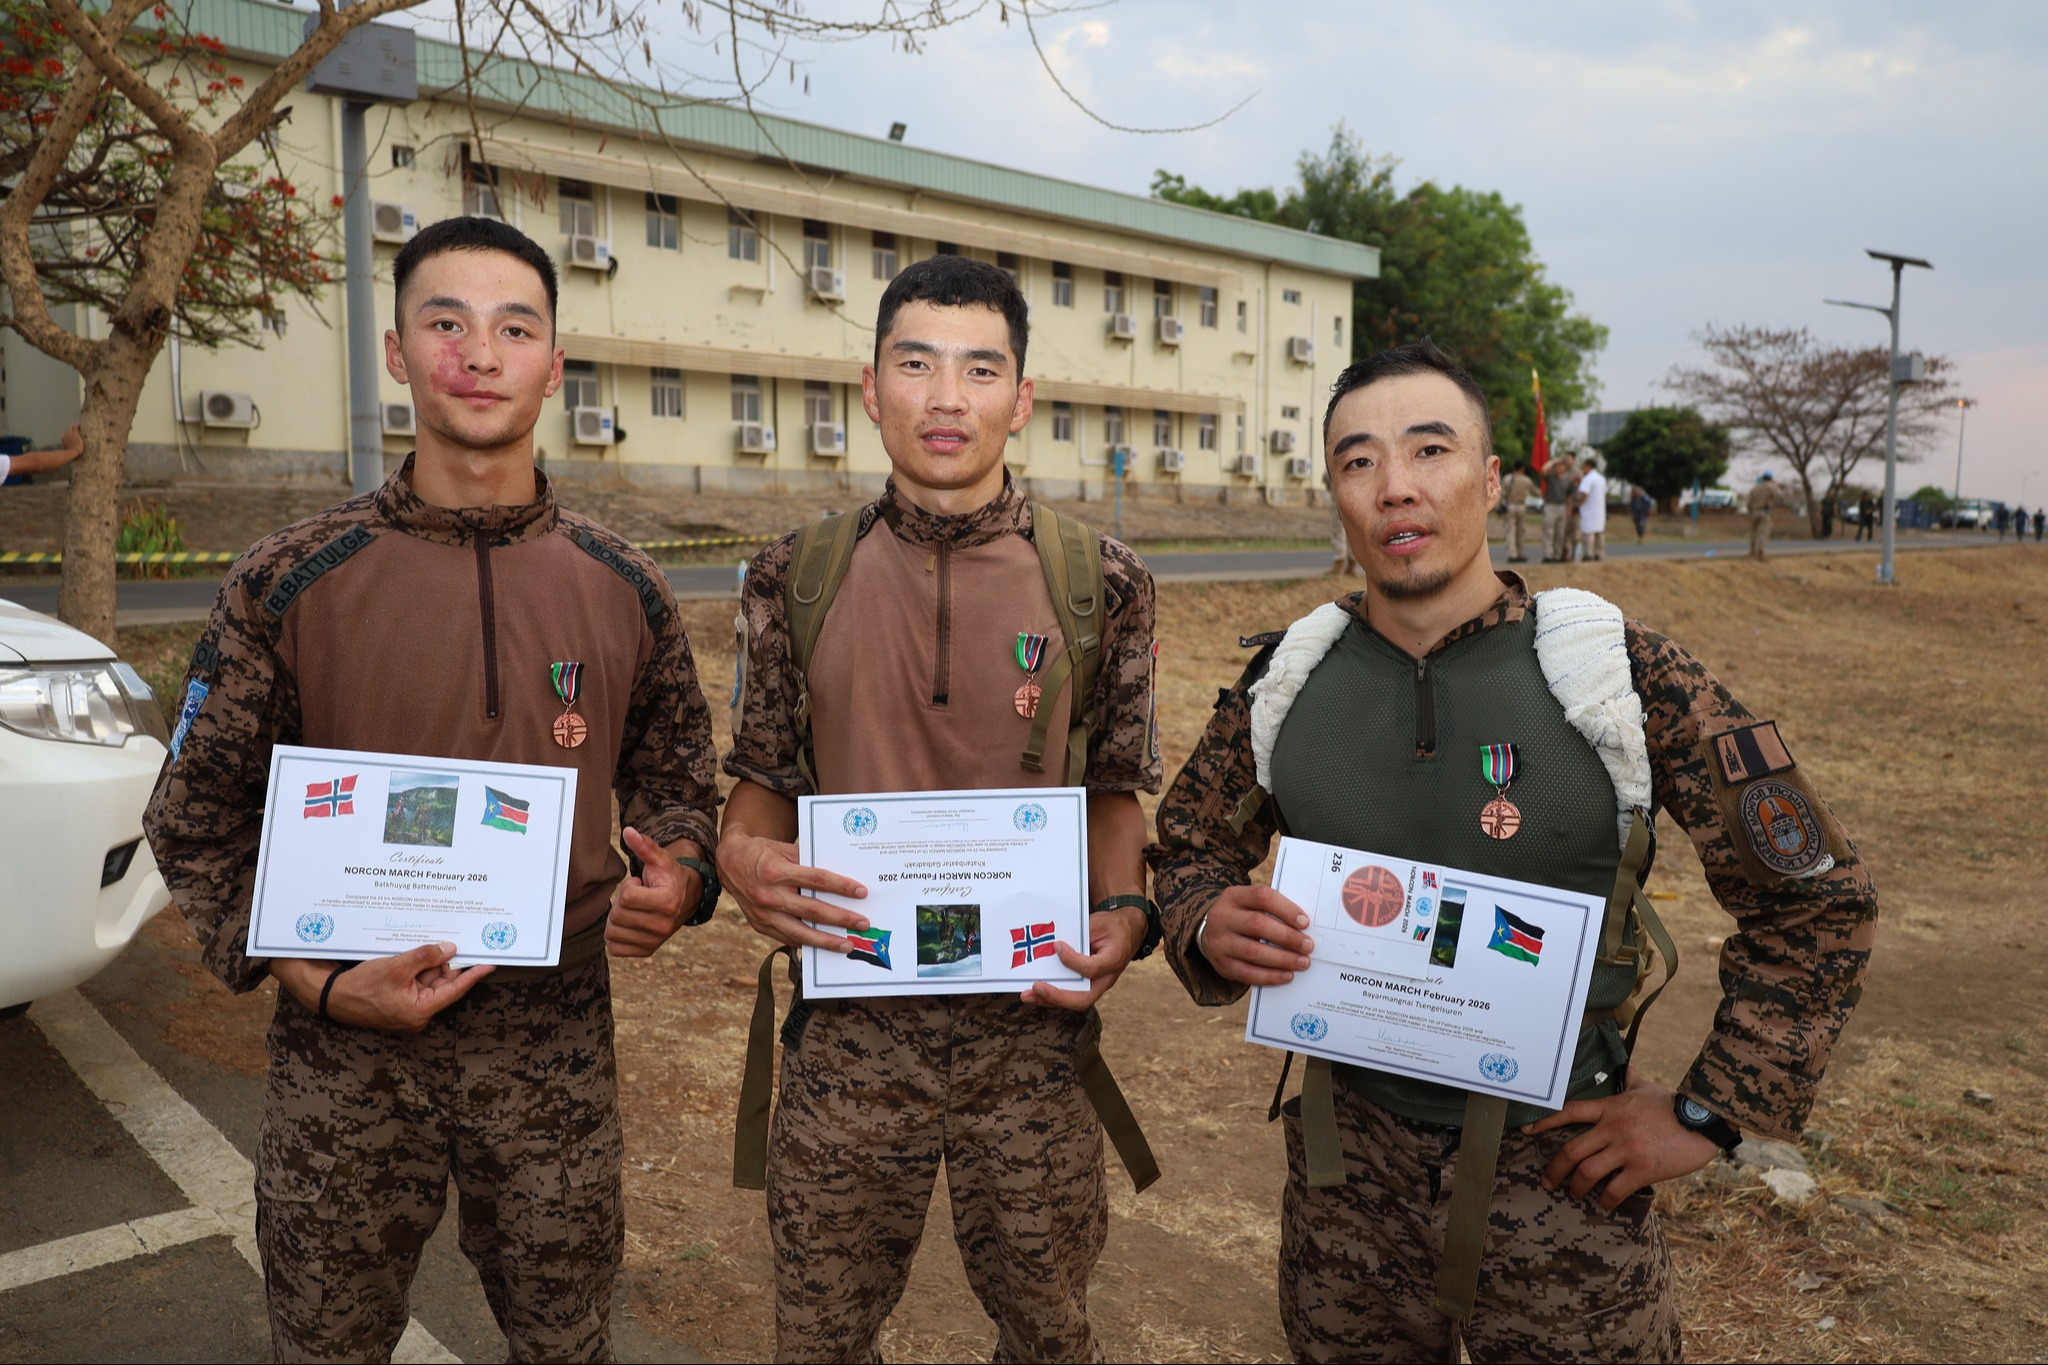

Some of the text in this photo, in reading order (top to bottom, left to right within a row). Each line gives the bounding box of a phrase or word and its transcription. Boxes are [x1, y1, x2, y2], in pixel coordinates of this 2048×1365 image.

[587, 540, 656, 609] MONGOLIA
[389, 850, 444, 866] Certificate
[1331, 852, 1342, 873] 236
[344, 866, 487, 882] NORCON MARCH February 2026
[878, 871, 1011, 881] NORCON MARCH February 2026
[1408, 866, 1417, 894] NORCON
[921, 882, 972, 897] Certificate
[1404, 895, 1412, 917] MARCH
[1339, 972, 1490, 1010] NORCON MARCH February 2026
[1385, 1009, 1408, 1018] NORCON
[1408, 1014, 1427, 1022] MARCH
[1415, 1000, 1462, 1016] Tsengelsuren
[1384, 1014, 1406, 1023] NORCON
